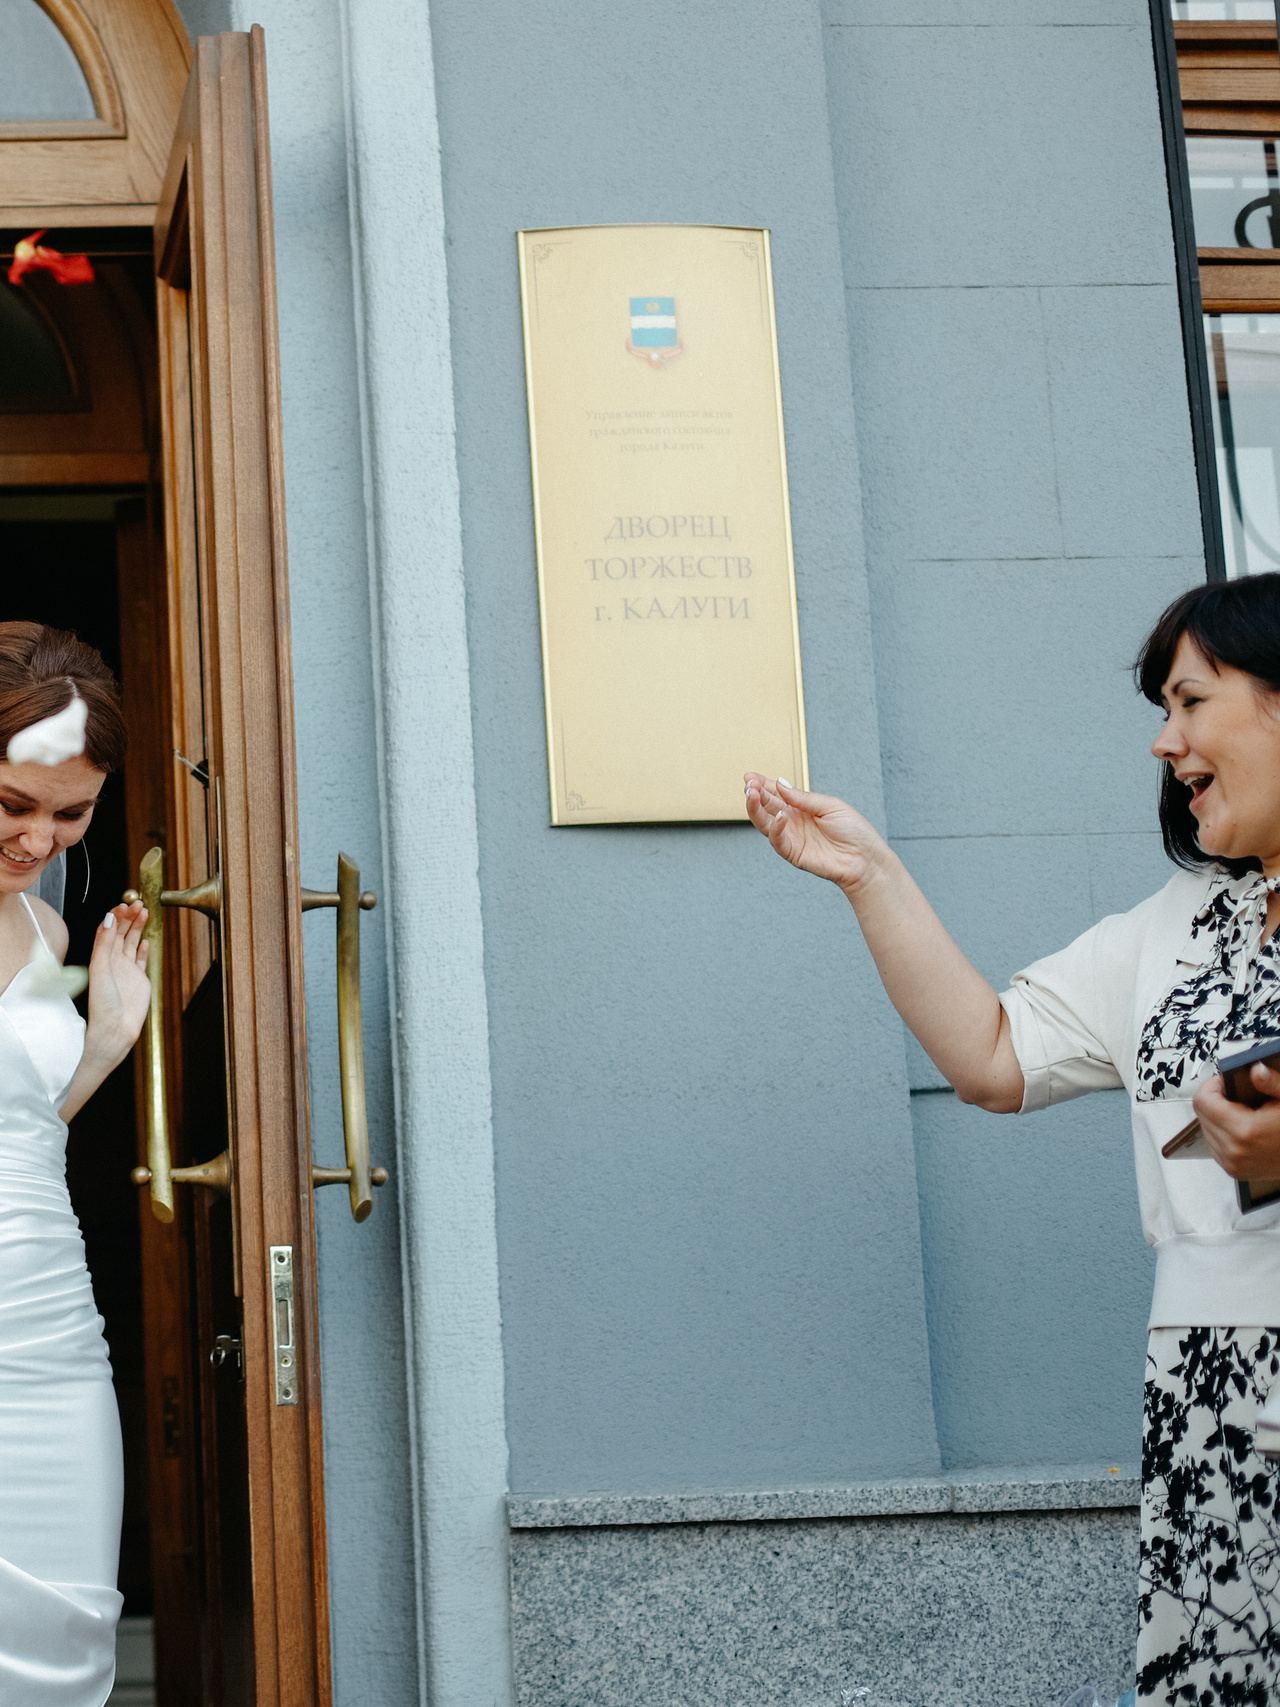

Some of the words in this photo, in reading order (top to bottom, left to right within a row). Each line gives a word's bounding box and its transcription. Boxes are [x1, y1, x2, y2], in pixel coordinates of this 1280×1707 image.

[604, 515, 732, 543] ДВОРЕЦ
[584, 555, 754, 581] ТОРЖЕСТВ
[594, 605, 613, 622] г.
[622, 595, 752, 621] КАЛУГИ
